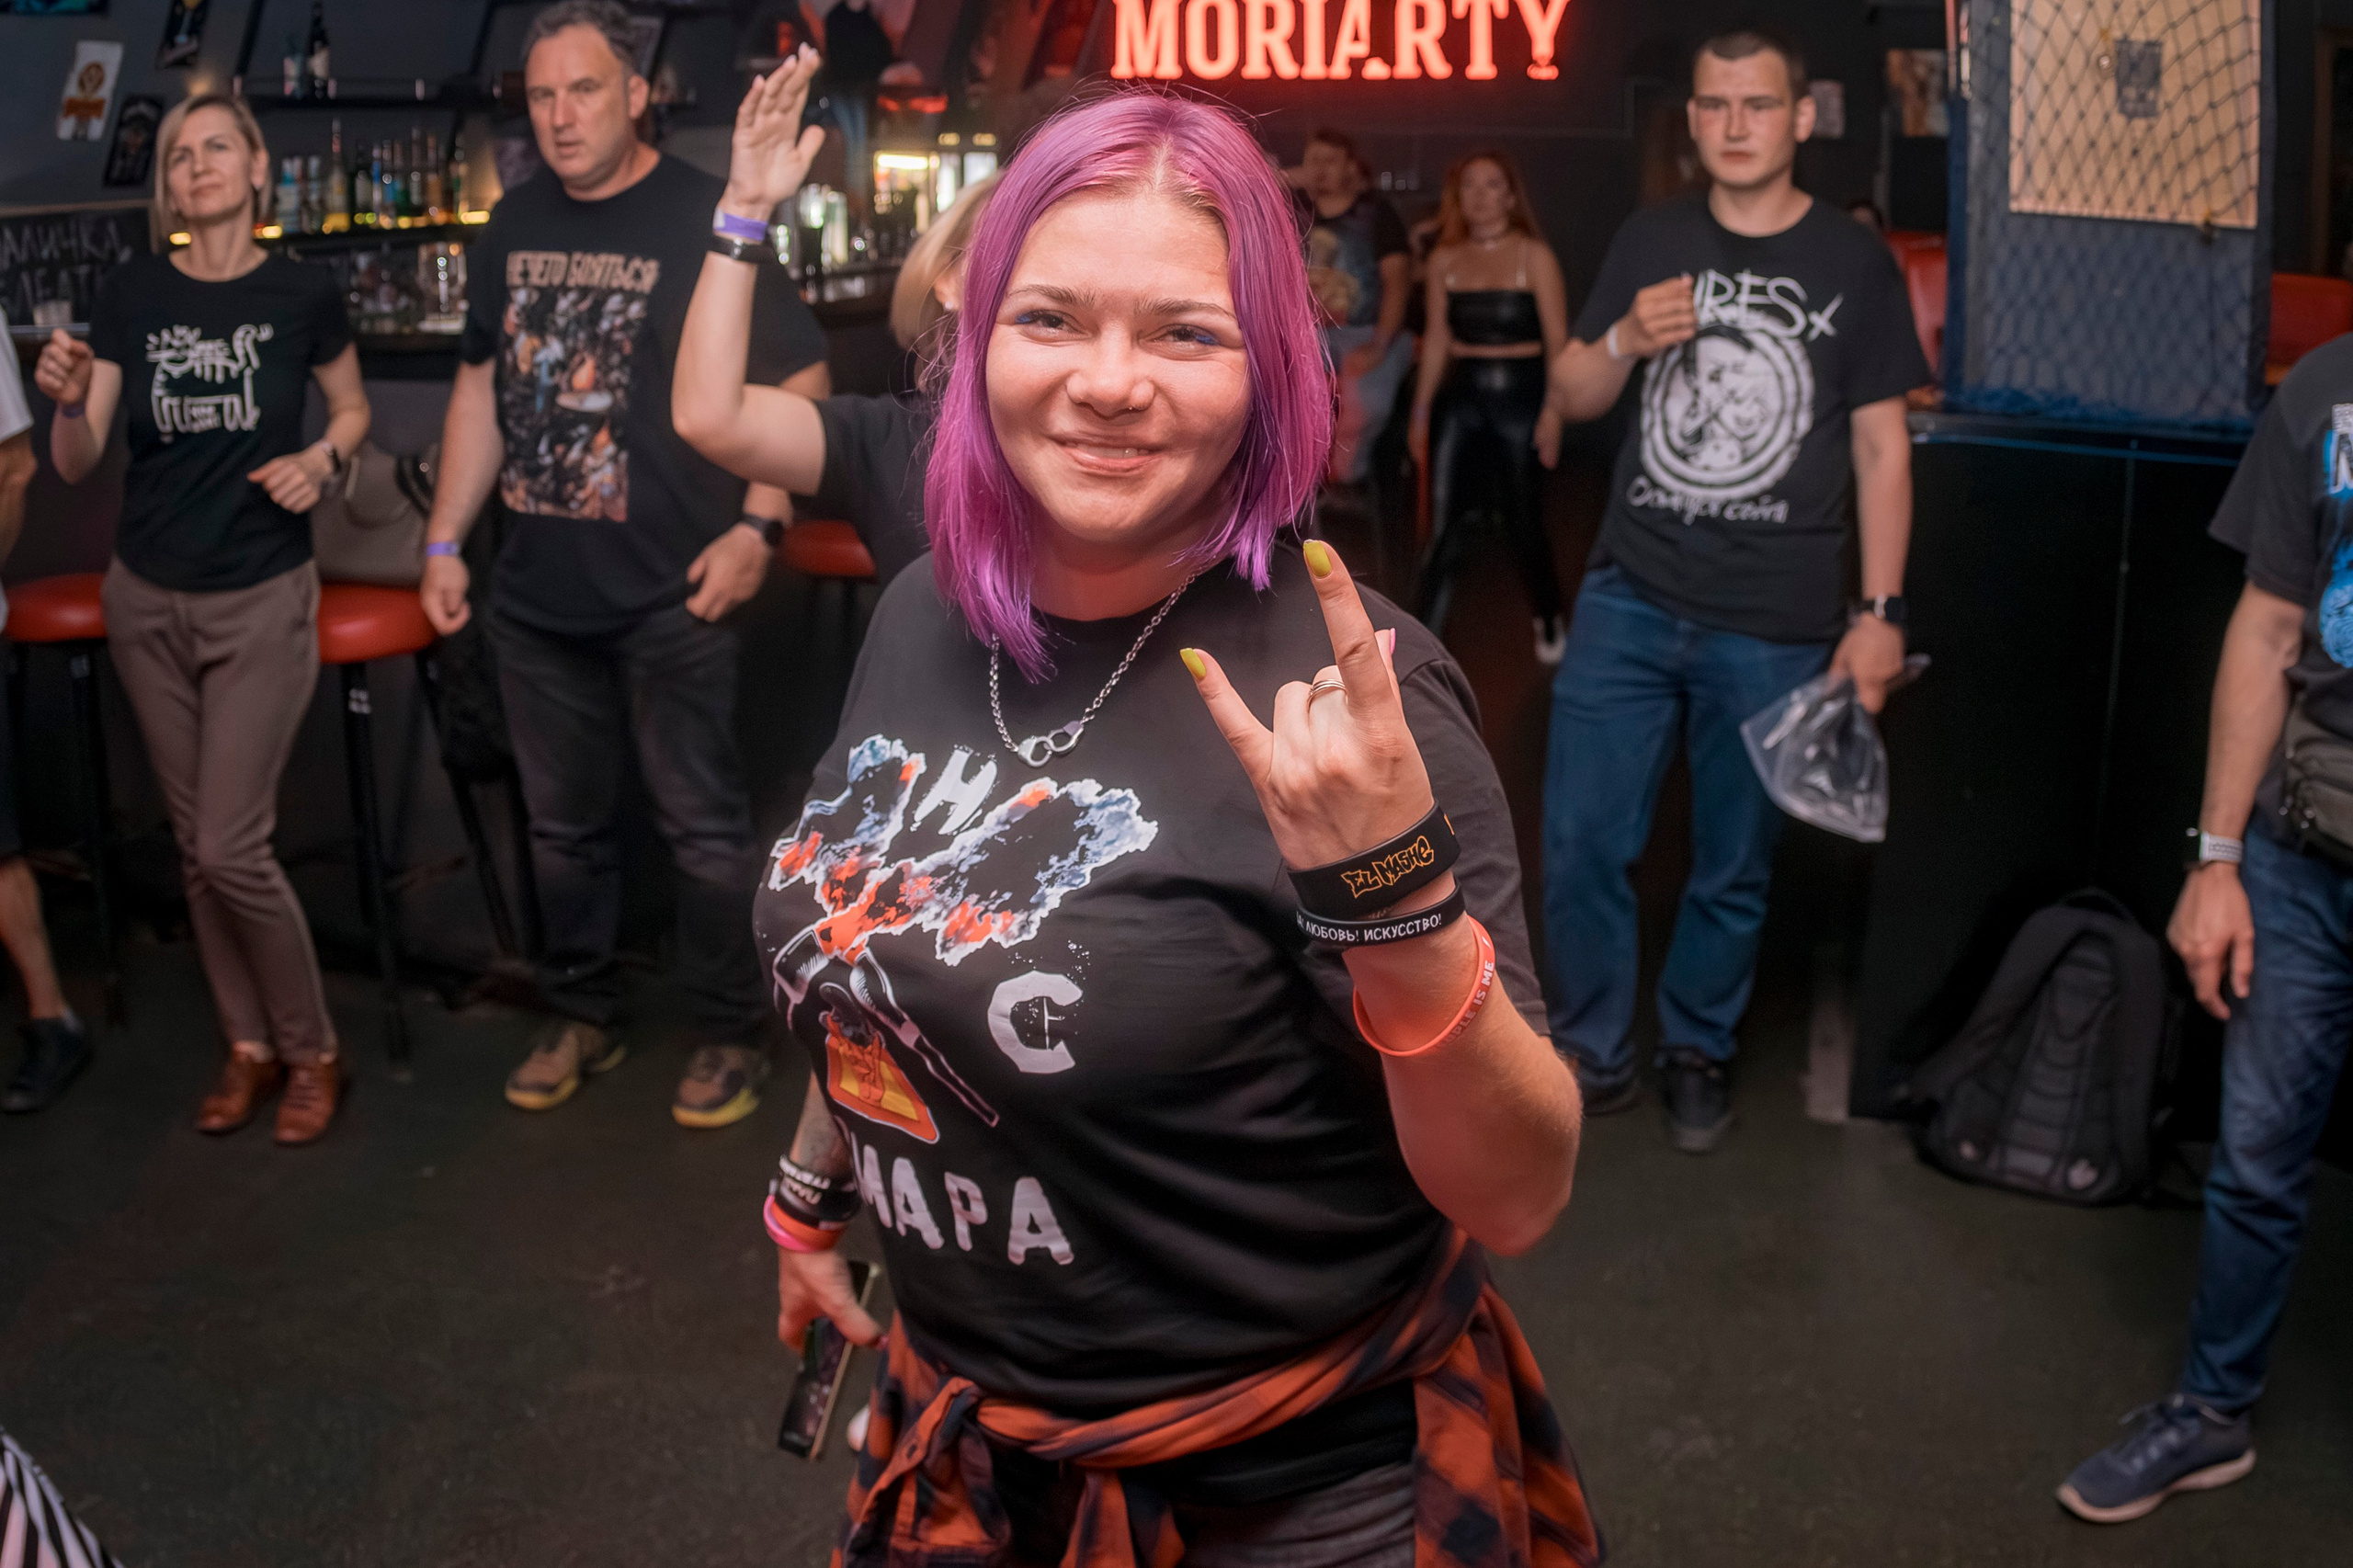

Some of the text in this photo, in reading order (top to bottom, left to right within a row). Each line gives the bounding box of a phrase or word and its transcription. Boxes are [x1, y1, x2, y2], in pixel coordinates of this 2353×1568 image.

[1110, 0, 1565, 80] MORIARTY
[1340, 869, 1382, 899] EL
[1305, 920, 1359, 942] ЛЮБОВЬ!
[1364, 913, 1442, 941] ИСКУССТВО!
[1472, 989, 1486, 1006] IS
[1481, 960, 1495, 986] ME
